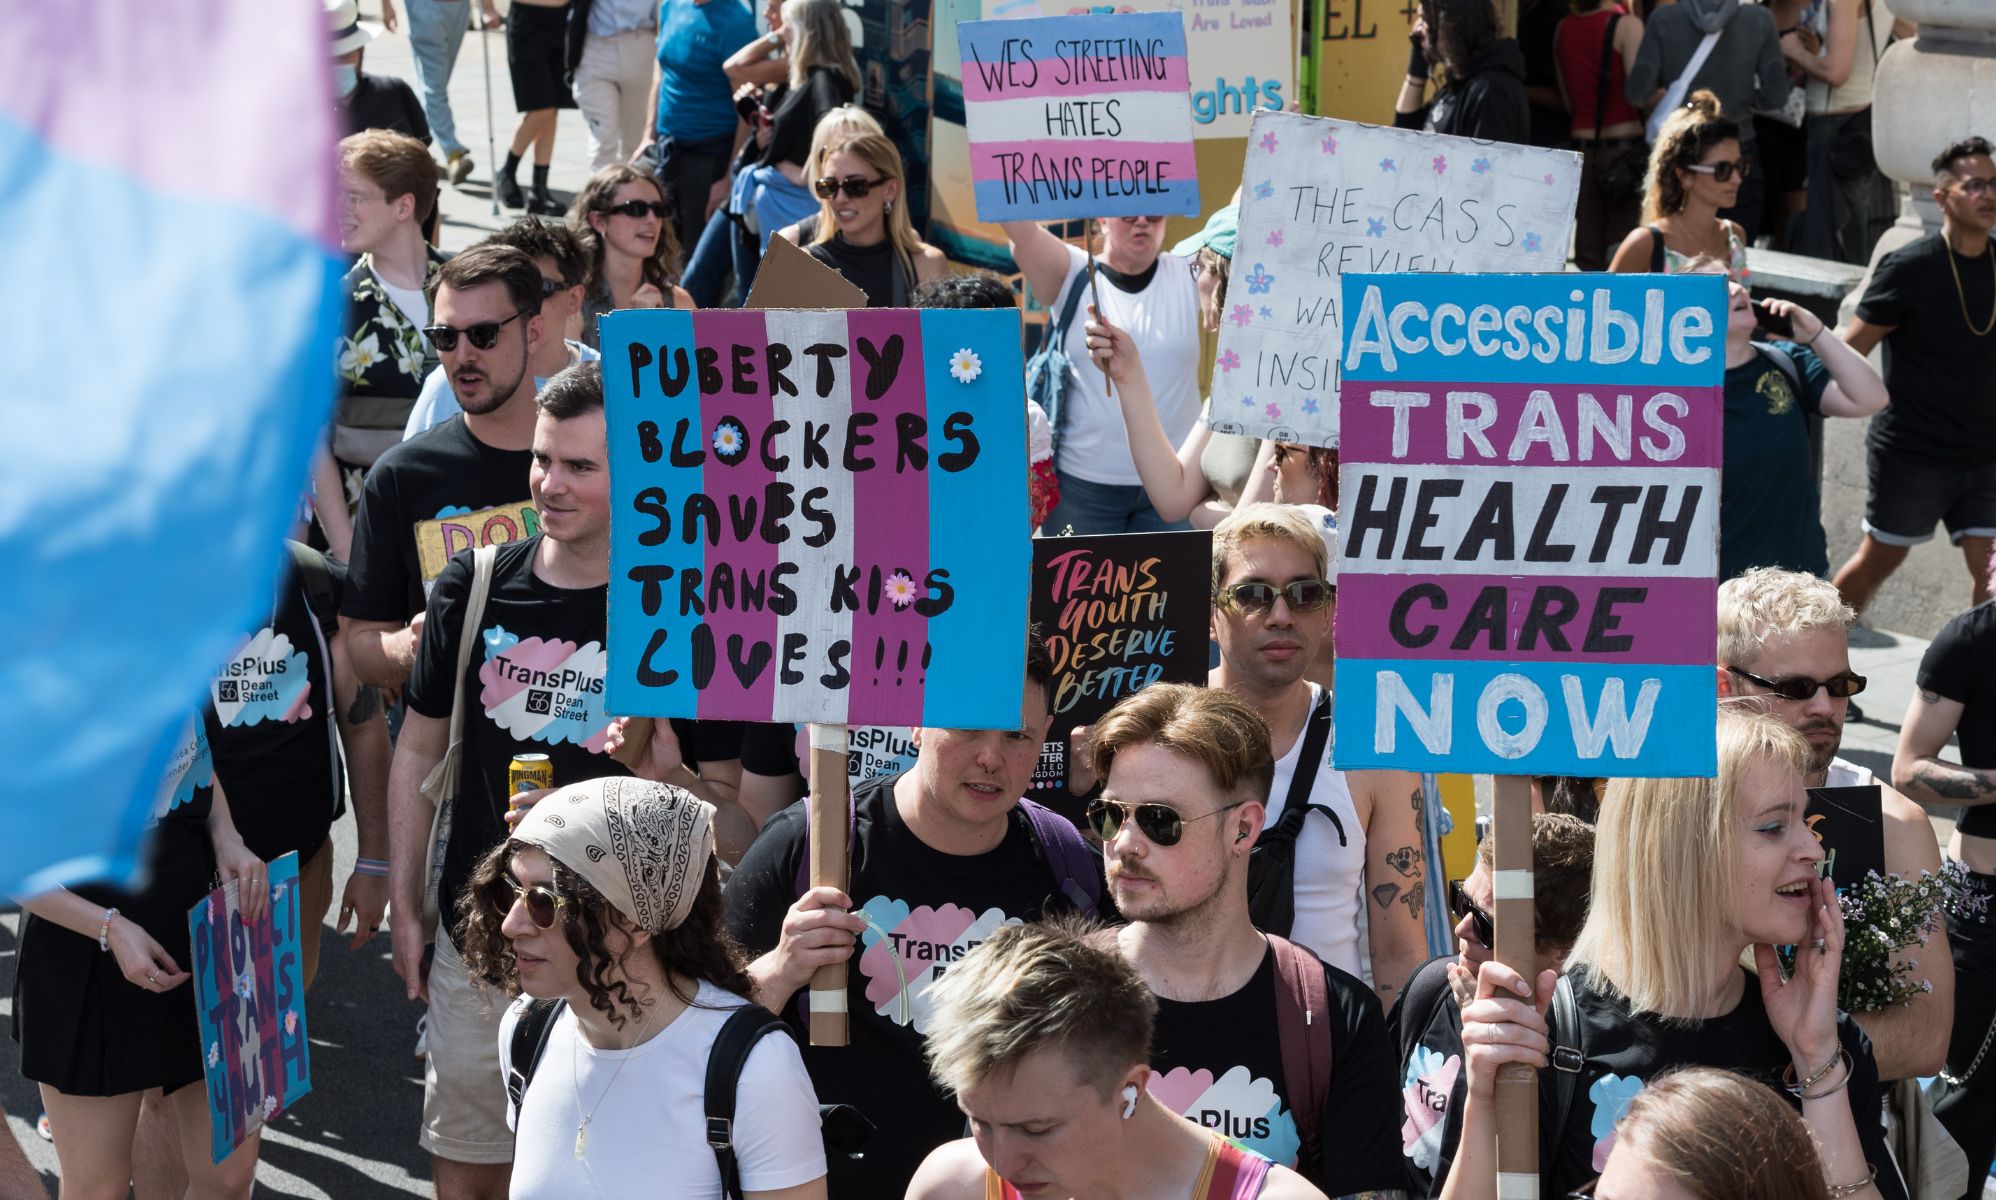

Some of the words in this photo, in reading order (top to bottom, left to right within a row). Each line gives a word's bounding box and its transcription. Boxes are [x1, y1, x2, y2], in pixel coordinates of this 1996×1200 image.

[1191, 12, 1220, 31] Are
[1231, 11, 1272, 30] Loved
[971, 39, 1038, 92] WES
[1055, 38, 1166, 85] STREETING
[1046, 99, 1122, 137] HATES
[1193, 77, 1283, 124] ghts
[992, 152, 1083, 205] TRANS
[1092, 157, 1171, 199] PEOPLE
[1289, 186, 1364, 224] THE
[1393, 193, 1517, 247] CASS
[1297, 297, 1338, 328] WA
[1346, 285, 1713, 373] Accessible
[628, 334, 904, 400] PUBERTY
[637, 411, 981, 474] BLOCKERS
[1369, 389, 1689, 462] TRANS
[633, 482, 837, 548] SAVES
[1344, 475, 1703, 565] HEALTH
[627, 562, 800, 617] TRANS
[830, 563, 955, 618] KIS
[1046, 549, 1162, 604] TRANS
[1058, 591, 1168, 644] YOUTH
[1388, 582, 1649, 653] CARE
[218, 656, 287, 677] nsPlus
[1046, 625, 1178, 676] DESERVE
[241, 680, 273, 691] Dean
[242, 691, 280, 703] Street
[496, 655, 604, 695] TransPlus
[553, 706, 589, 722] Street
[555, 692, 584, 708] Dean
[1375, 670, 1662, 760] NOW
[848, 728, 920, 758] sPlus
[866, 753, 900, 771] Dean
[1037, 753, 1064, 763] TER
[1041, 742, 1064, 752] ETS
[511, 769, 547, 785] WINGMAN
[1036, 763, 1064, 771] ITED
[209, 952, 297, 1063] TRANS
[1417, 1078, 1447, 1113] Tra
